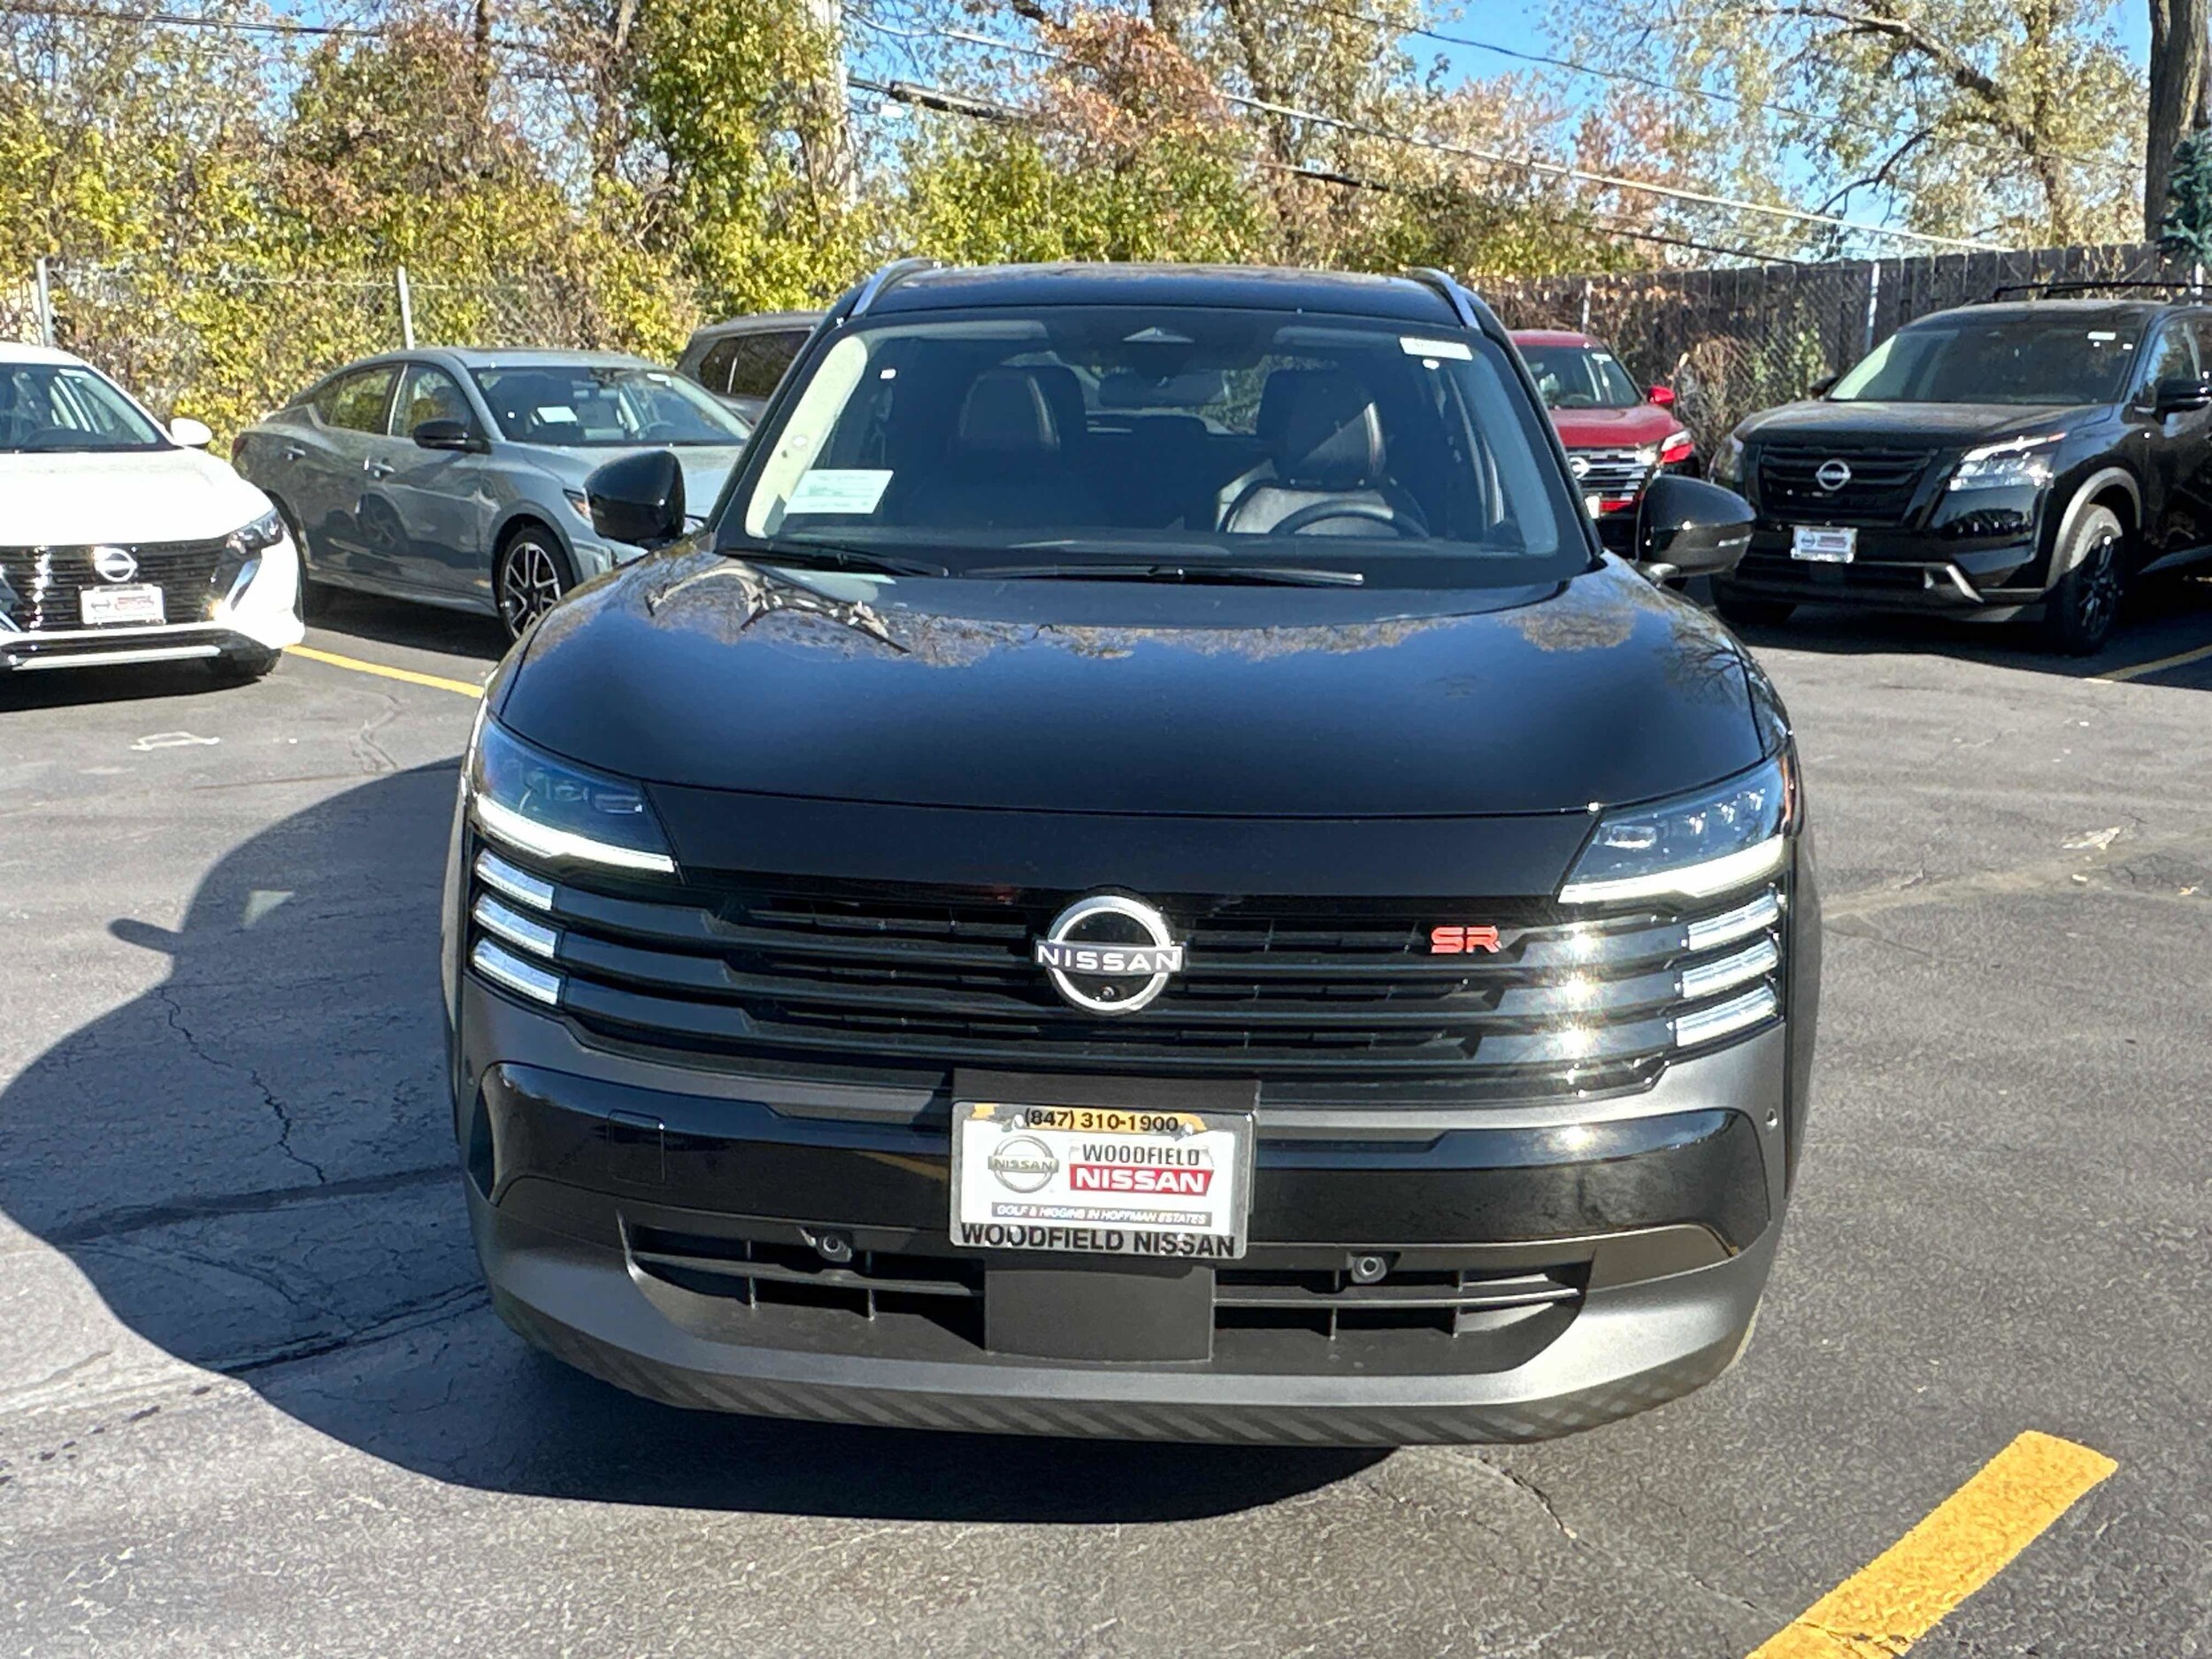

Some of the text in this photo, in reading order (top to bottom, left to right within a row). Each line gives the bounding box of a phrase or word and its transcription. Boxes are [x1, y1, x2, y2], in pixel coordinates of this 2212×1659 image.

[1431, 926, 1500, 954] SR
[1037, 945, 1180, 972] NISSAN
[1025, 1108, 1179, 1132] (847) 310-1900
[994, 1157, 1054, 1171] NISSAN
[1083, 1143, 1200, 1166] WOODFIELD
[1076, 1168, 1204, 1193] NISSAN
[997, 1203, 1026, 1217] GOLF
[1039, 1206, 1086, 1220] HIGGINS
[1101, 1210, 1157, 1223] HOFFMAN
[1158, 1211, 1207, 1225] ESTATES
[962, 1224, 1235, 1257] WOODFIELD NISSAN
